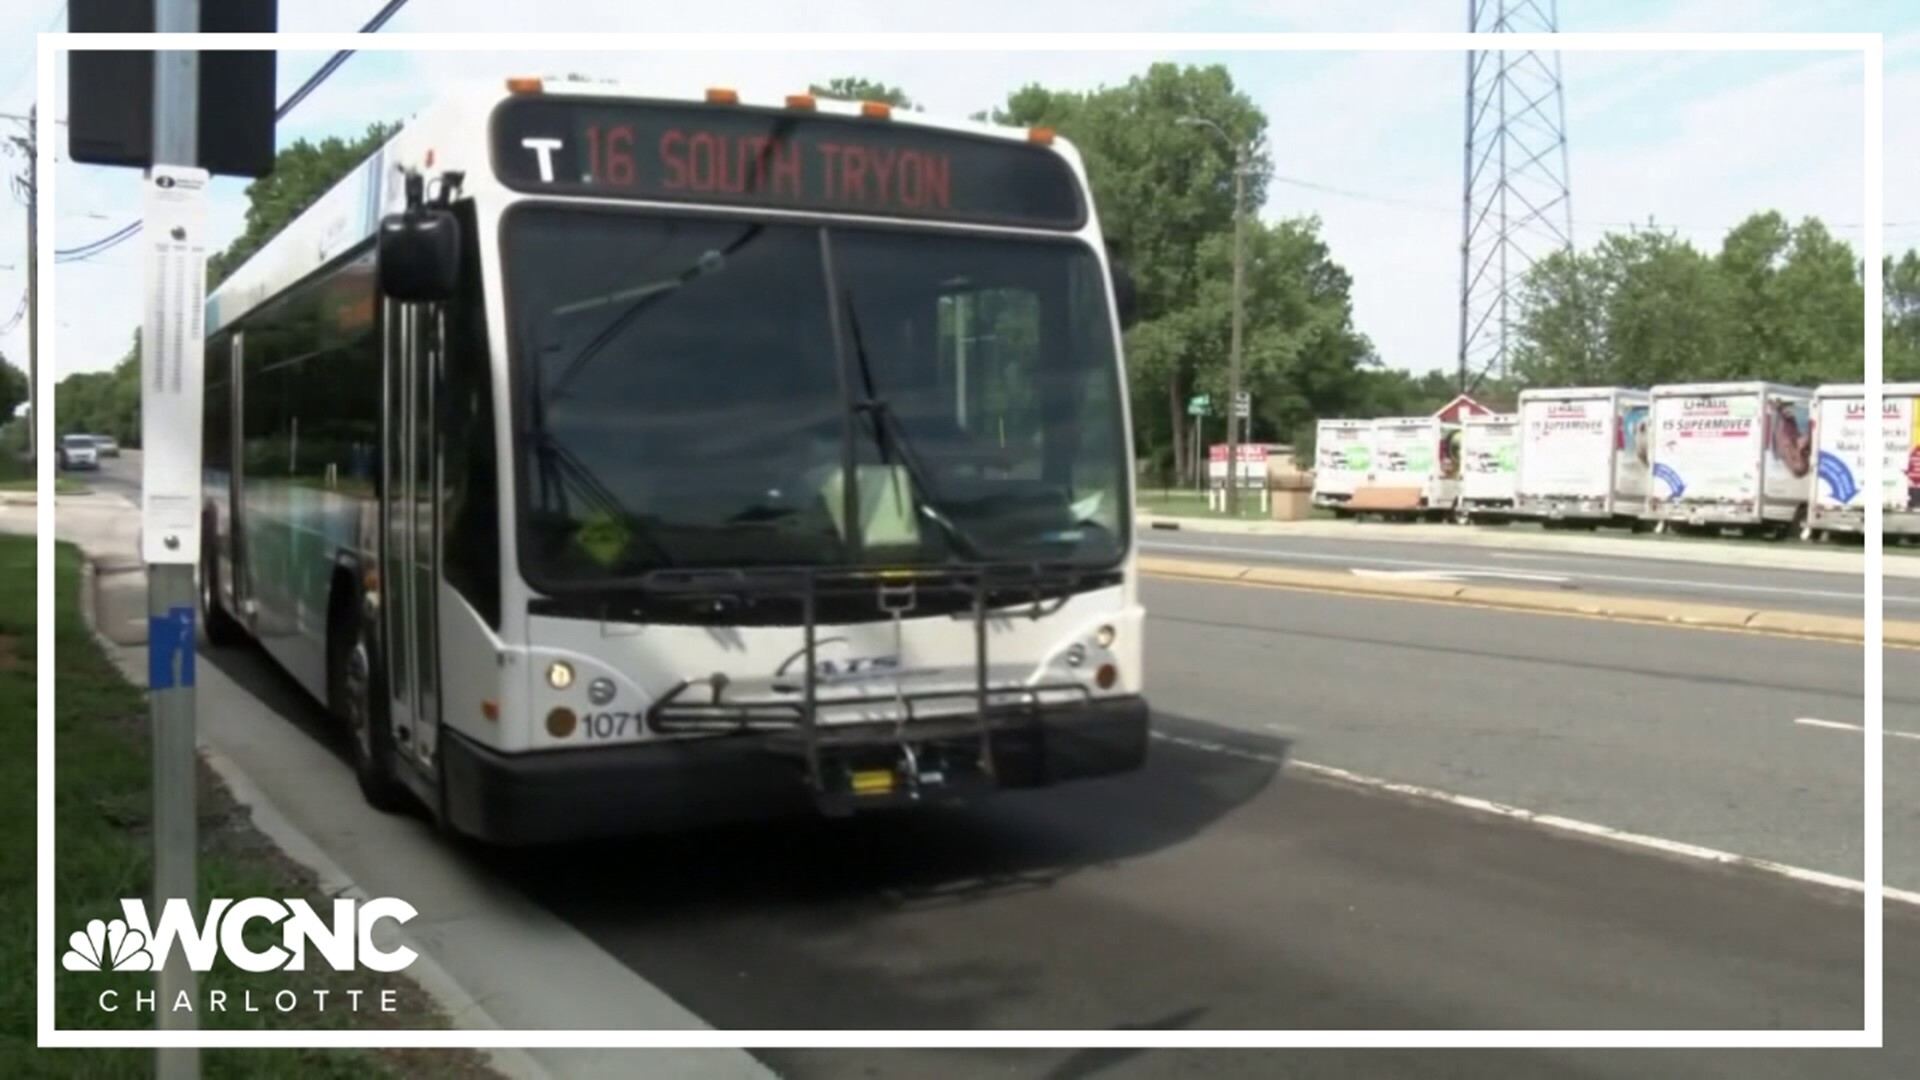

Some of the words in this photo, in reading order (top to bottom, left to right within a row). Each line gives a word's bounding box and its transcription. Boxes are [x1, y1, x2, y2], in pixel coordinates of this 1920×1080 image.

[522, 138, 563, 183] T
[584, 125, 636, 187] 16
[659, 130, 802, 200] SOUTH
[821, 144, 952, 209] TRYON
[1676, 418, 1752, 431] SUPERMOVER
[582, 711, 644, 739] 1071
